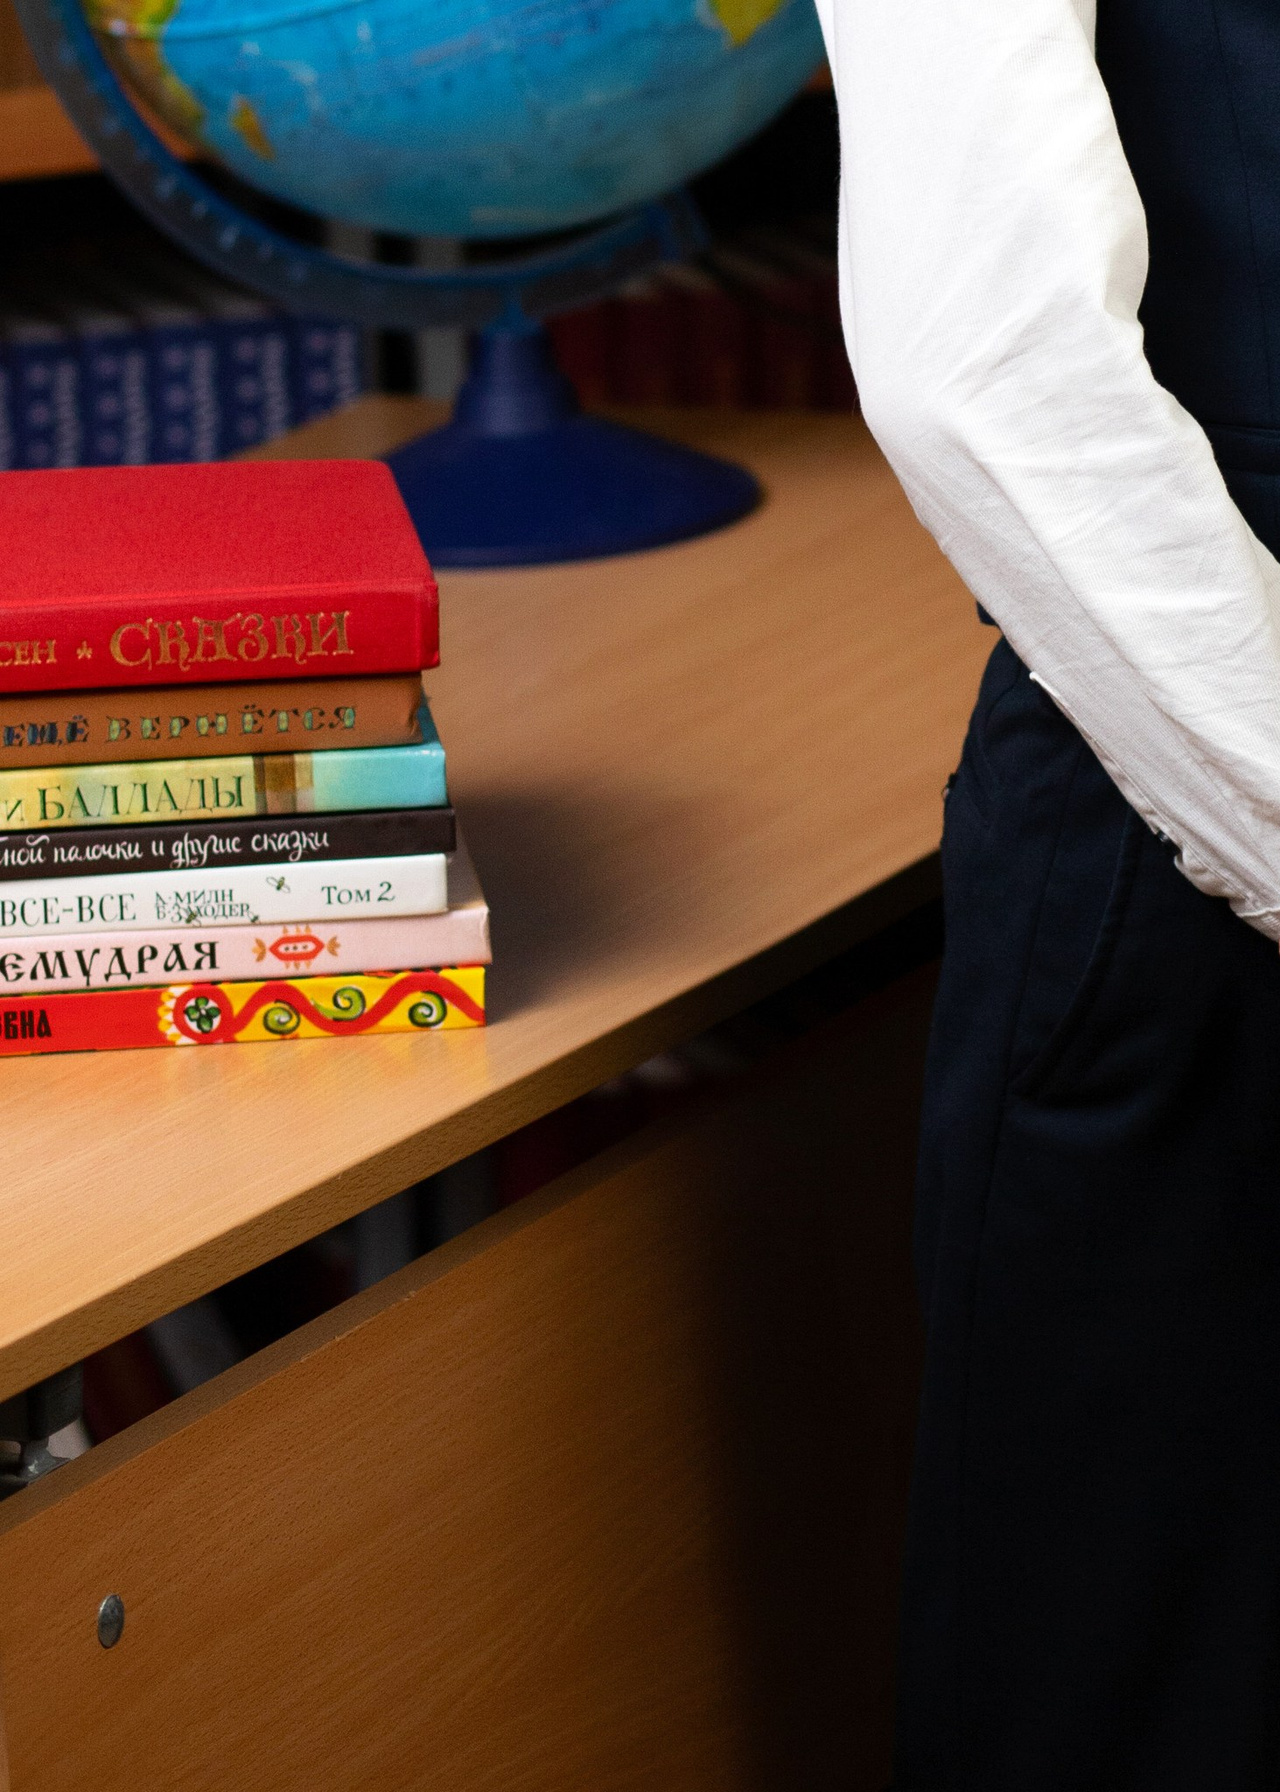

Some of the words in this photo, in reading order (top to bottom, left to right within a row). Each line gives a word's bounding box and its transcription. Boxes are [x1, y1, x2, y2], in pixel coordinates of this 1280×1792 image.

[109, 610, 355, 671] СКАЗКИ
[3, 714, 89, 747] ЕЩЁ
[105, 705, 356, 743] ВЕРНЁТСЯ
[37, 775, 245, 822] БАЛЛАДЫ
[0, 834, 50, 867] ной
[53, 841, 144, 864] палочки
[151, 839, 165, 857] и
[170, 832, 243, 869] другие
[251, 830, 330, 862] сказки
[321, 885, 371, 906] Том
[377, 881, 396, 903] 2
[0, 941, 220, 987] ЕМУДРАЯ
[0, 1009, 52, 1040] ВНА
